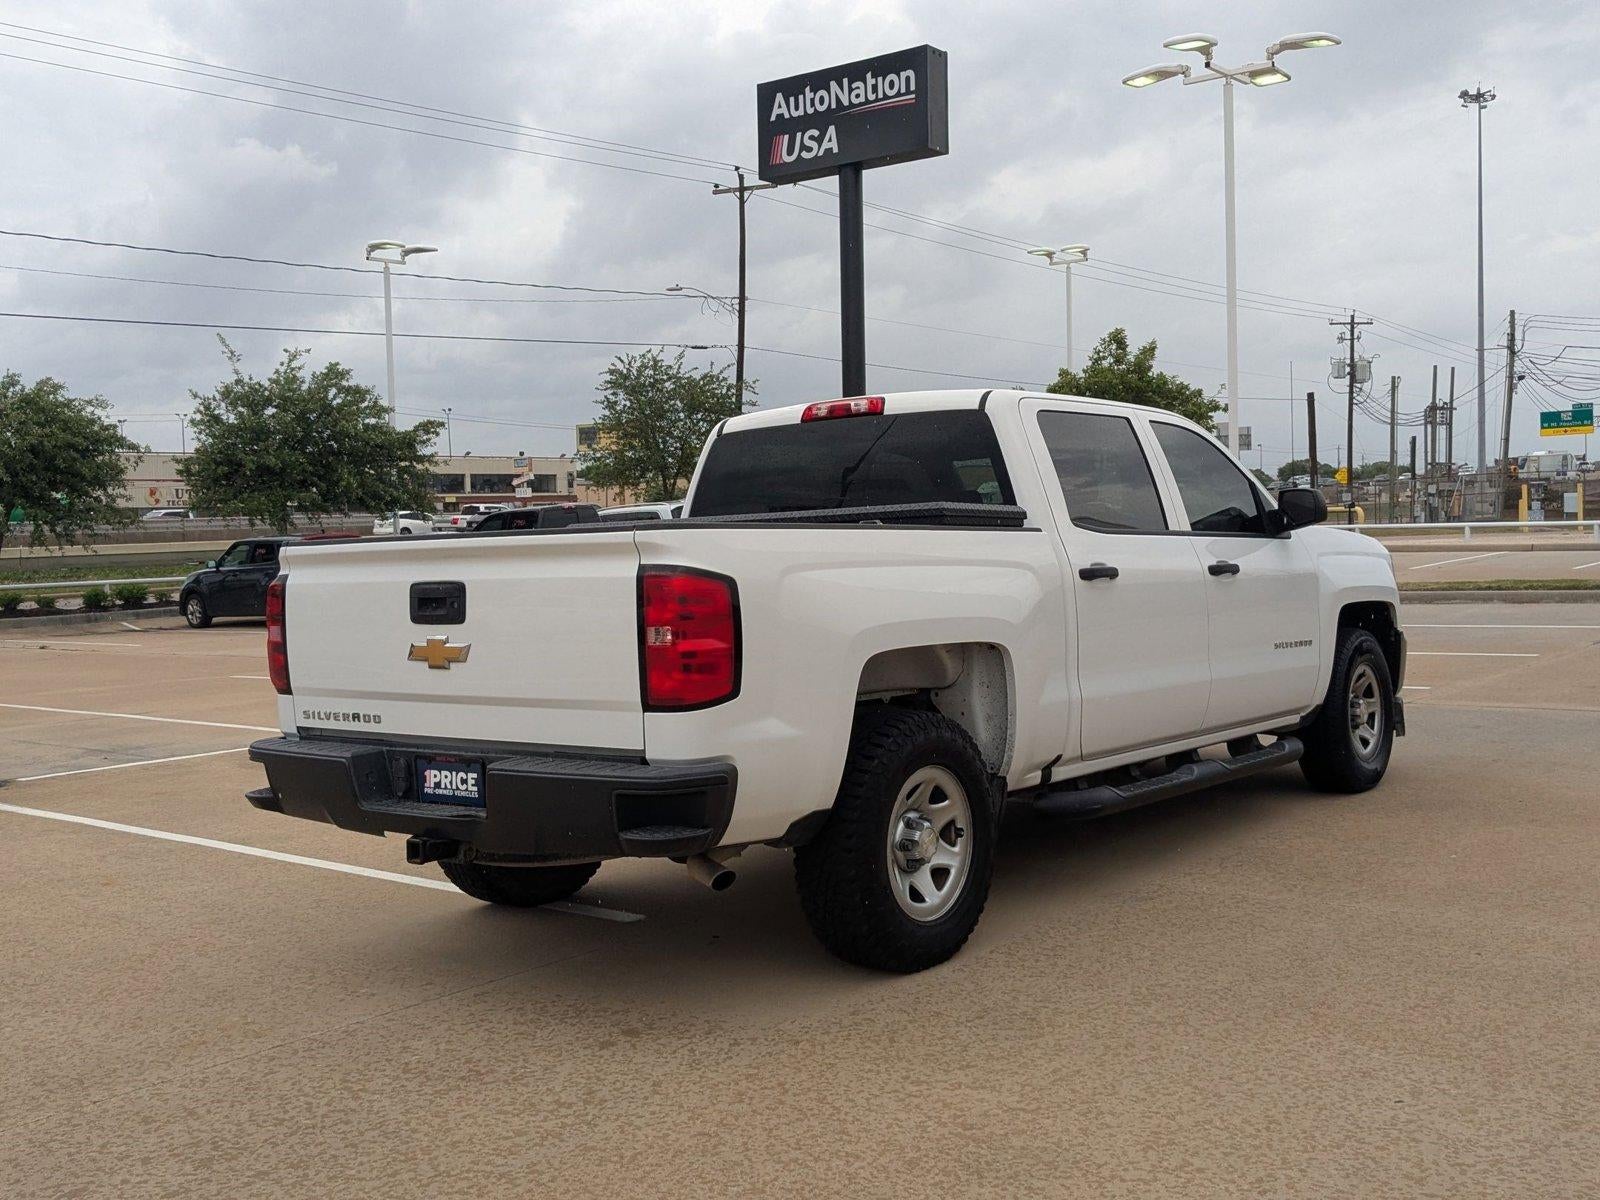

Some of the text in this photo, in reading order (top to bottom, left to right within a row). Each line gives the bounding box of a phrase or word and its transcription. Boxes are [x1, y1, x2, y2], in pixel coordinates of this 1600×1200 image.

[770, 69, 916, 122] AutoNation
[781, 125, 839, 163] USA
[1274, 639, 1313, 650] SILVERADO
[302, 709, 382, 724] SILVERADO
[424, 787, 479, 798] PRE-OWNED VEHICLES
